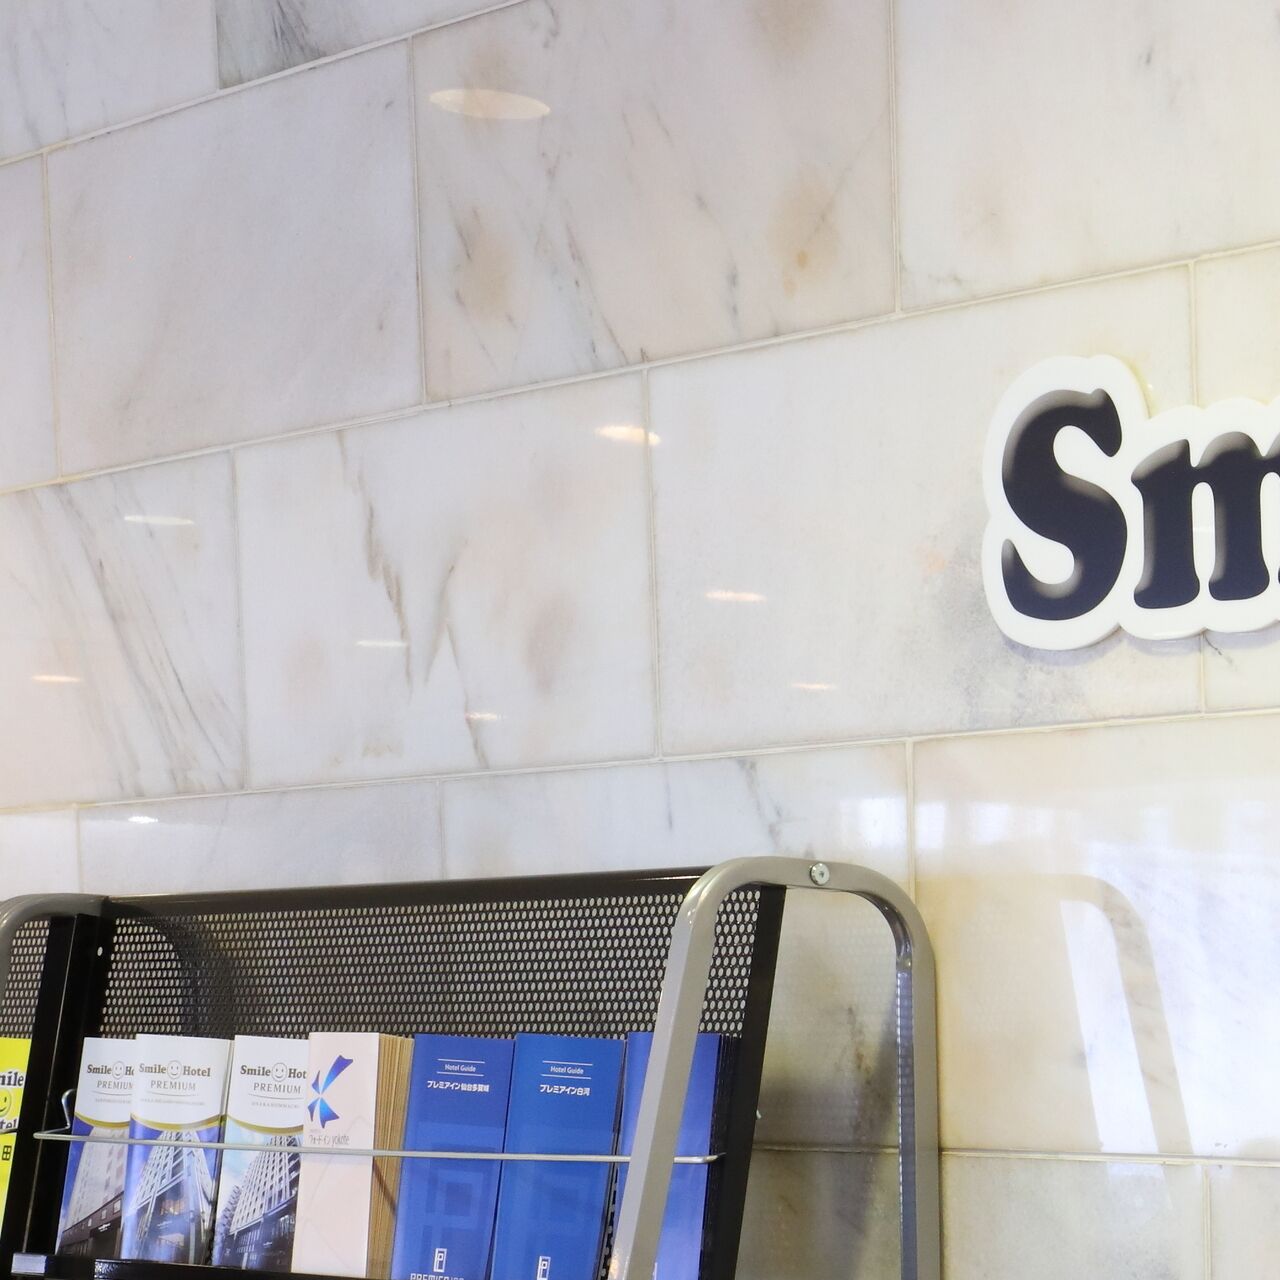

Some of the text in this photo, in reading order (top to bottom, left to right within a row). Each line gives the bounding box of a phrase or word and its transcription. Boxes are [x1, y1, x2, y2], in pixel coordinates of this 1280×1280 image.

[87, 1064, 111, 1075] Smile
[139, 1063, 166, 1074] Smile
[183, 1066, 211, 1077] Hotel
[240, 1064, 306, 1079] Smile Hot
[444, 1063, 476, 1073] Hotel Guide
[550, 1065, 584, 1075] Hotel Guide
[0, 1071, 24, 1087] ile
[150, 1080, 196, 1091] PREMIUM
[253, 1082, 301, 1094] PREMIUM
[540, 1084, 591, 1097] プレミアイン白河
